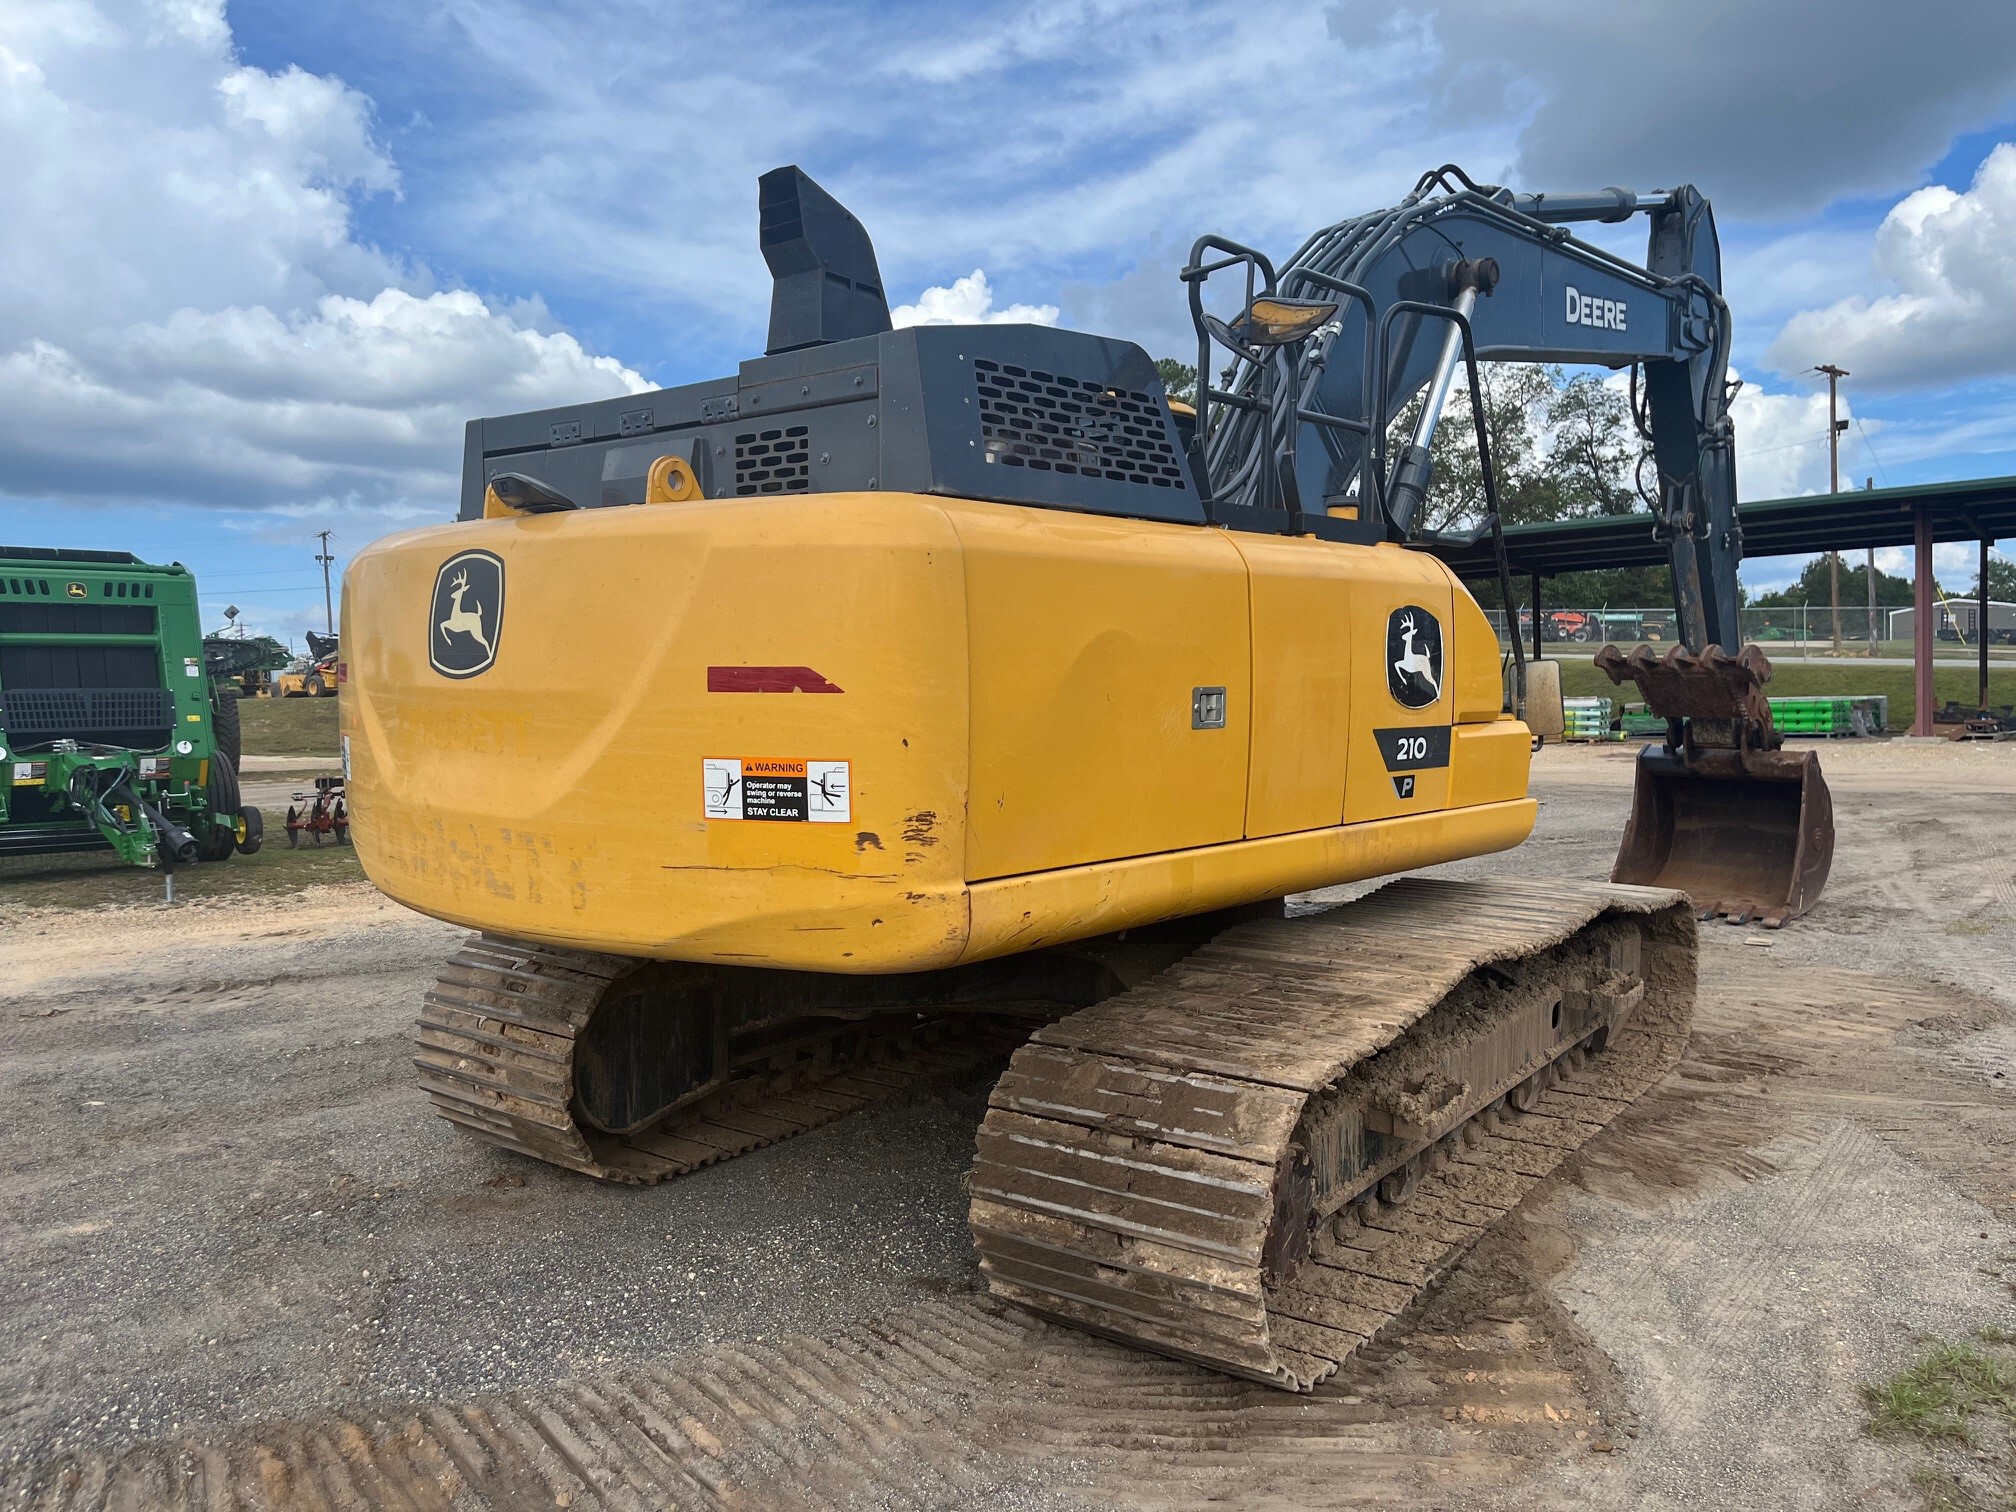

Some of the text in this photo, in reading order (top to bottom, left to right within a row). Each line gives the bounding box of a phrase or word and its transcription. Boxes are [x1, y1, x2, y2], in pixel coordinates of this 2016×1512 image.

[1566, 286, 1626, 331] DEERE
[1397, 737, 1427, 760] 210
[755, 763, 803, 772] WARNING
[746, 781, 792, 791] Operator may
[1401, 778, 1413, 796] P
[747, 807, 799, 817] STAY CLEAR
